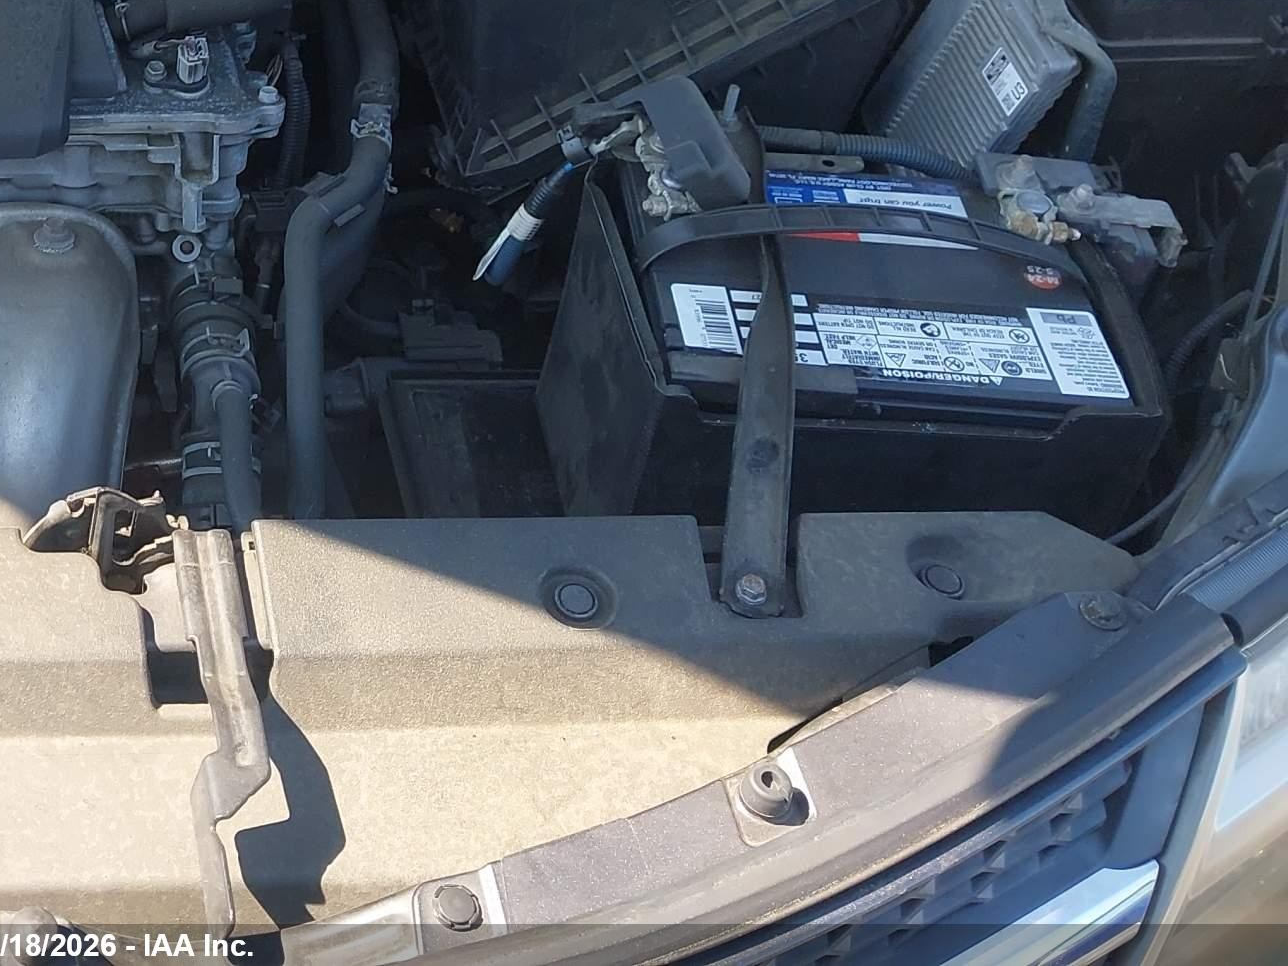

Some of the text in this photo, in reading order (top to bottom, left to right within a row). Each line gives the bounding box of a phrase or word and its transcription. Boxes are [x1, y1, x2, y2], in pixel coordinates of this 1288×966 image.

[1010, 81, 1026, 101] U3
[901, 199, 921, 207] you
[921, 201, 953, 209] Power
[1055, 314, 1077, 324] Pb
[881, 368, 991, 383] DANGER/POISON
